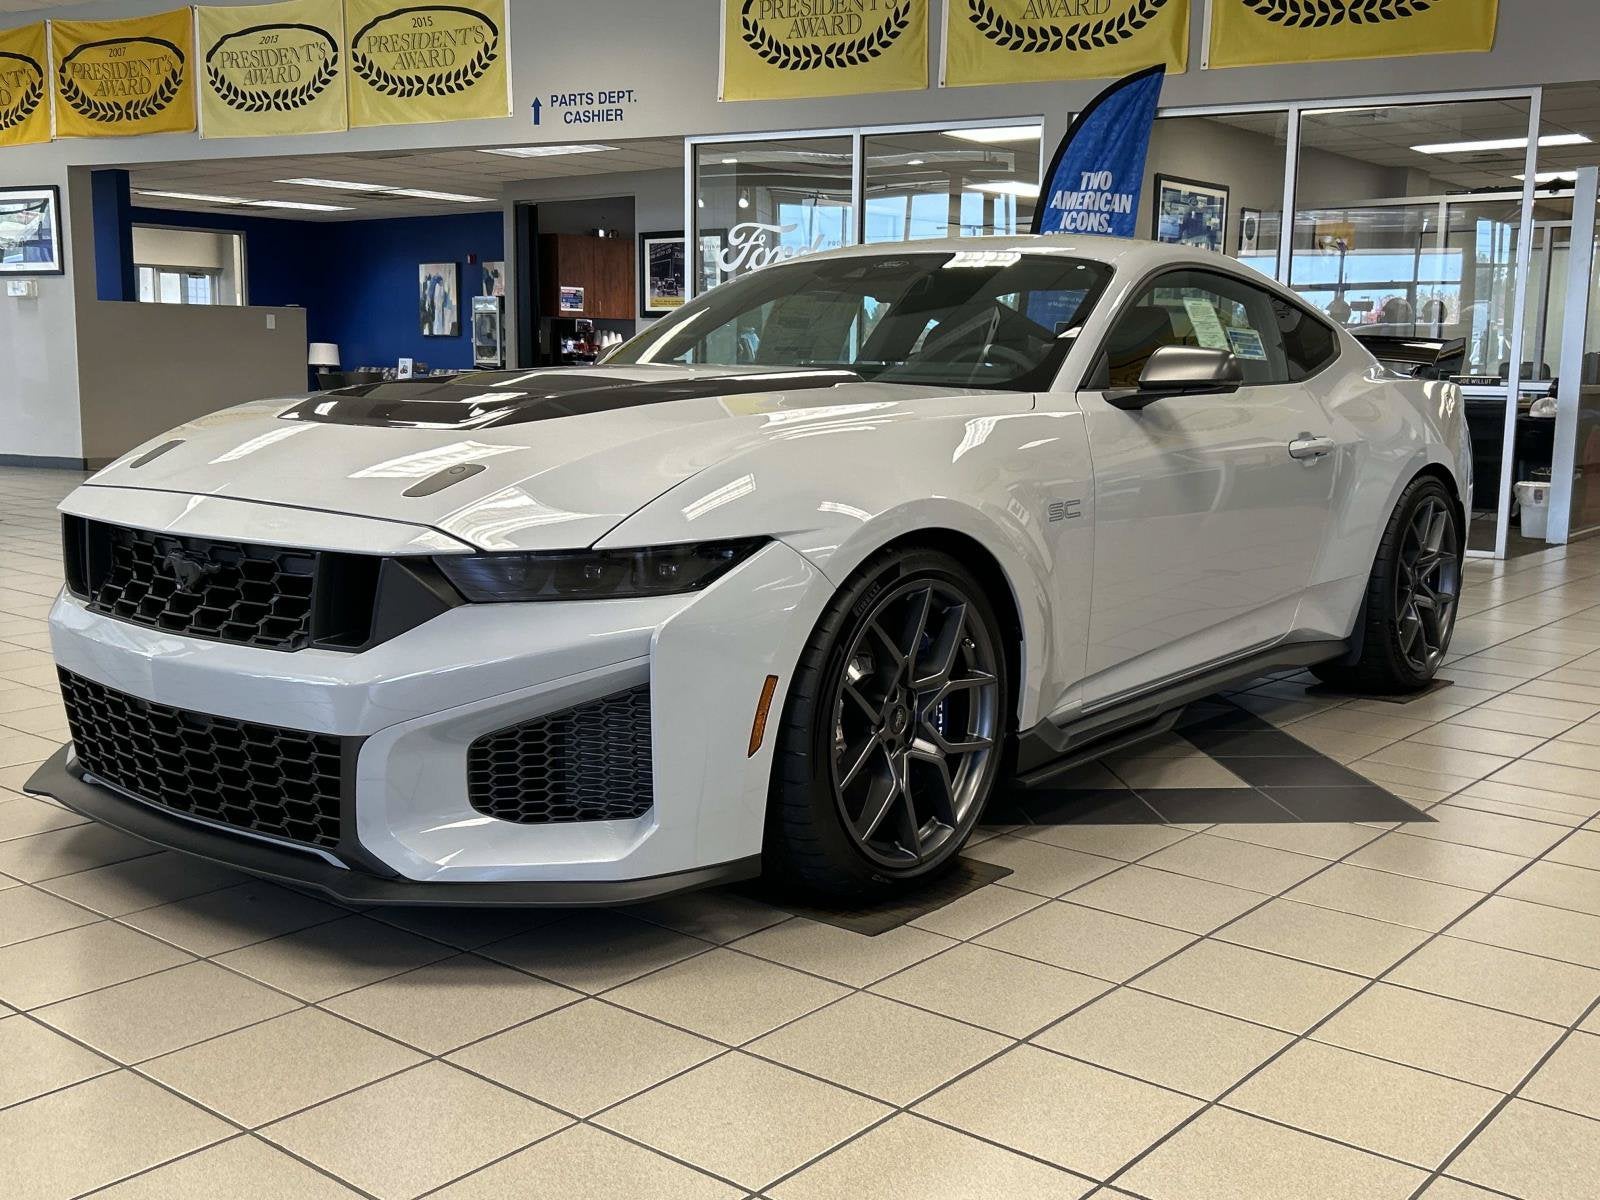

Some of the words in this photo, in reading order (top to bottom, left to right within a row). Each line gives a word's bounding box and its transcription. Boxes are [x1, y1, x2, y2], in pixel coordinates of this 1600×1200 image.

[1020, 0, 1111, 20] AWARD
[412, 16, 433, 28] 2015
[786, 13, 862, 40] AWARD
[259, 34, 280, 45] 2013
[366, 25, 485, 54] PRESIDENT'S
[108, 47, 127, 58] 2007
[220, 42, 326, 69] PRESIDENT'S
[392, 47, 456, 71] AWARD
[71, 54, 173, 80] PRESIDENT'S
[243, 64, 301, 86] AWARD
[94, 77, 152, 97] AWARD
[550, 92, 594, 107] PARTS
[598, 89, 638, 105] DEPT.
[563, 108, 624, 125] CASHIER
[1080, 170, 1113, 191] TWO
[1049, 190, 1133, 214] AMERICAN
[1059, 211, 1113, 233] ICONS.
[1048, 499, 1081, 522] SC
